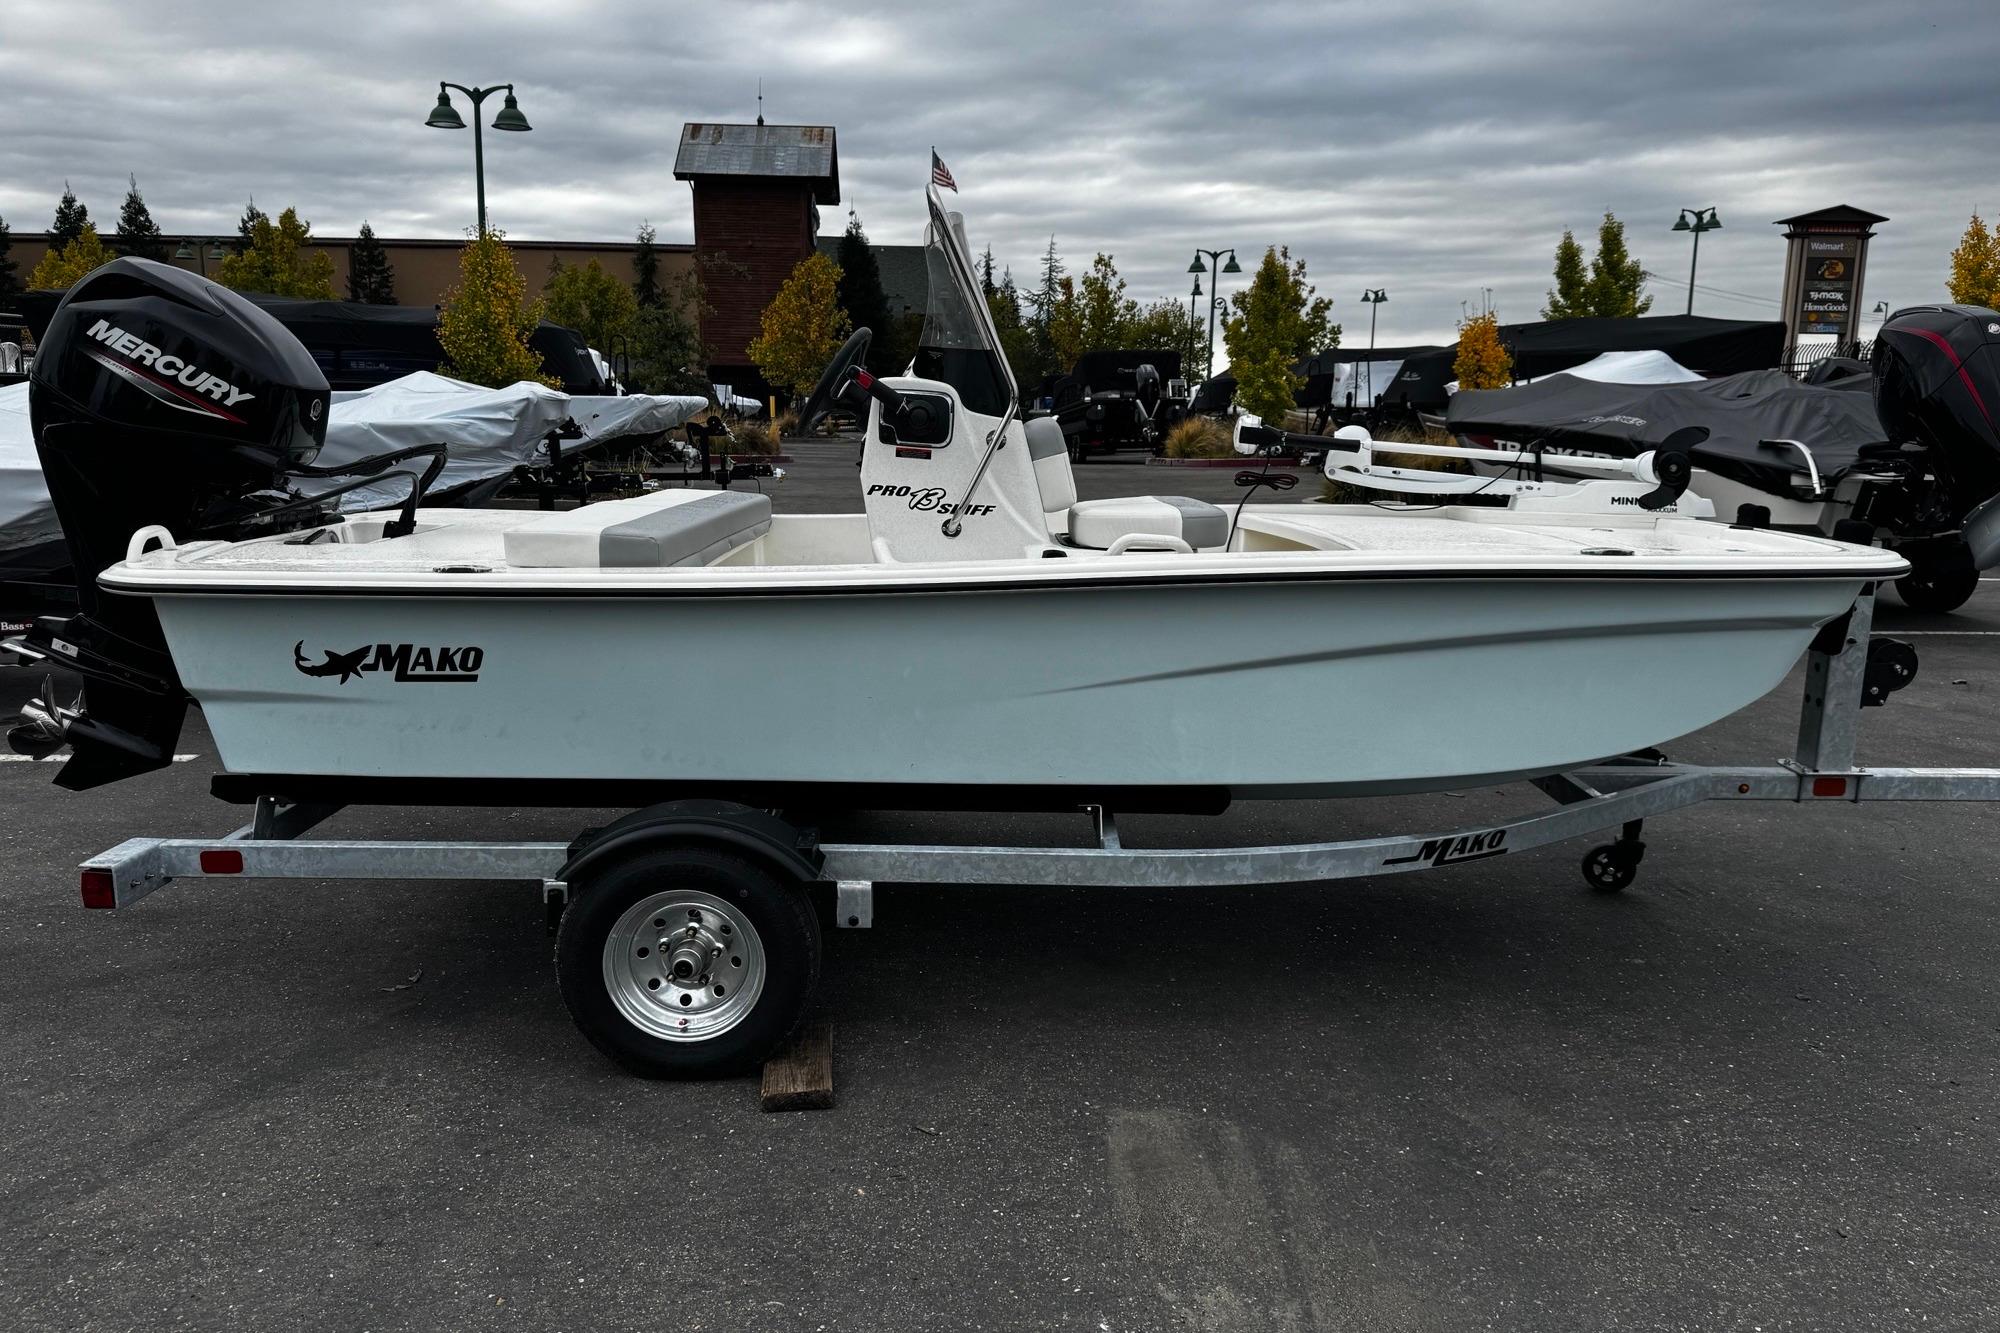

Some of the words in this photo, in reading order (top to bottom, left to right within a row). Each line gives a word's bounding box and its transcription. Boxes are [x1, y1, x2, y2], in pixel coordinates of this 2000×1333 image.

[1811, 242, 1844, 251] Walmart
[1803, 302, 1848, 311] HomeGoods
[86, 319, 255, 407] MERCURY
[867, 484, 911, 496] PRO
[908, 487, 947, 511] 13
[0, 621, 25, 631] Bass
[360, 644, 484, 682] MAKO
[1382, 829, 1509, 867] MAKO
